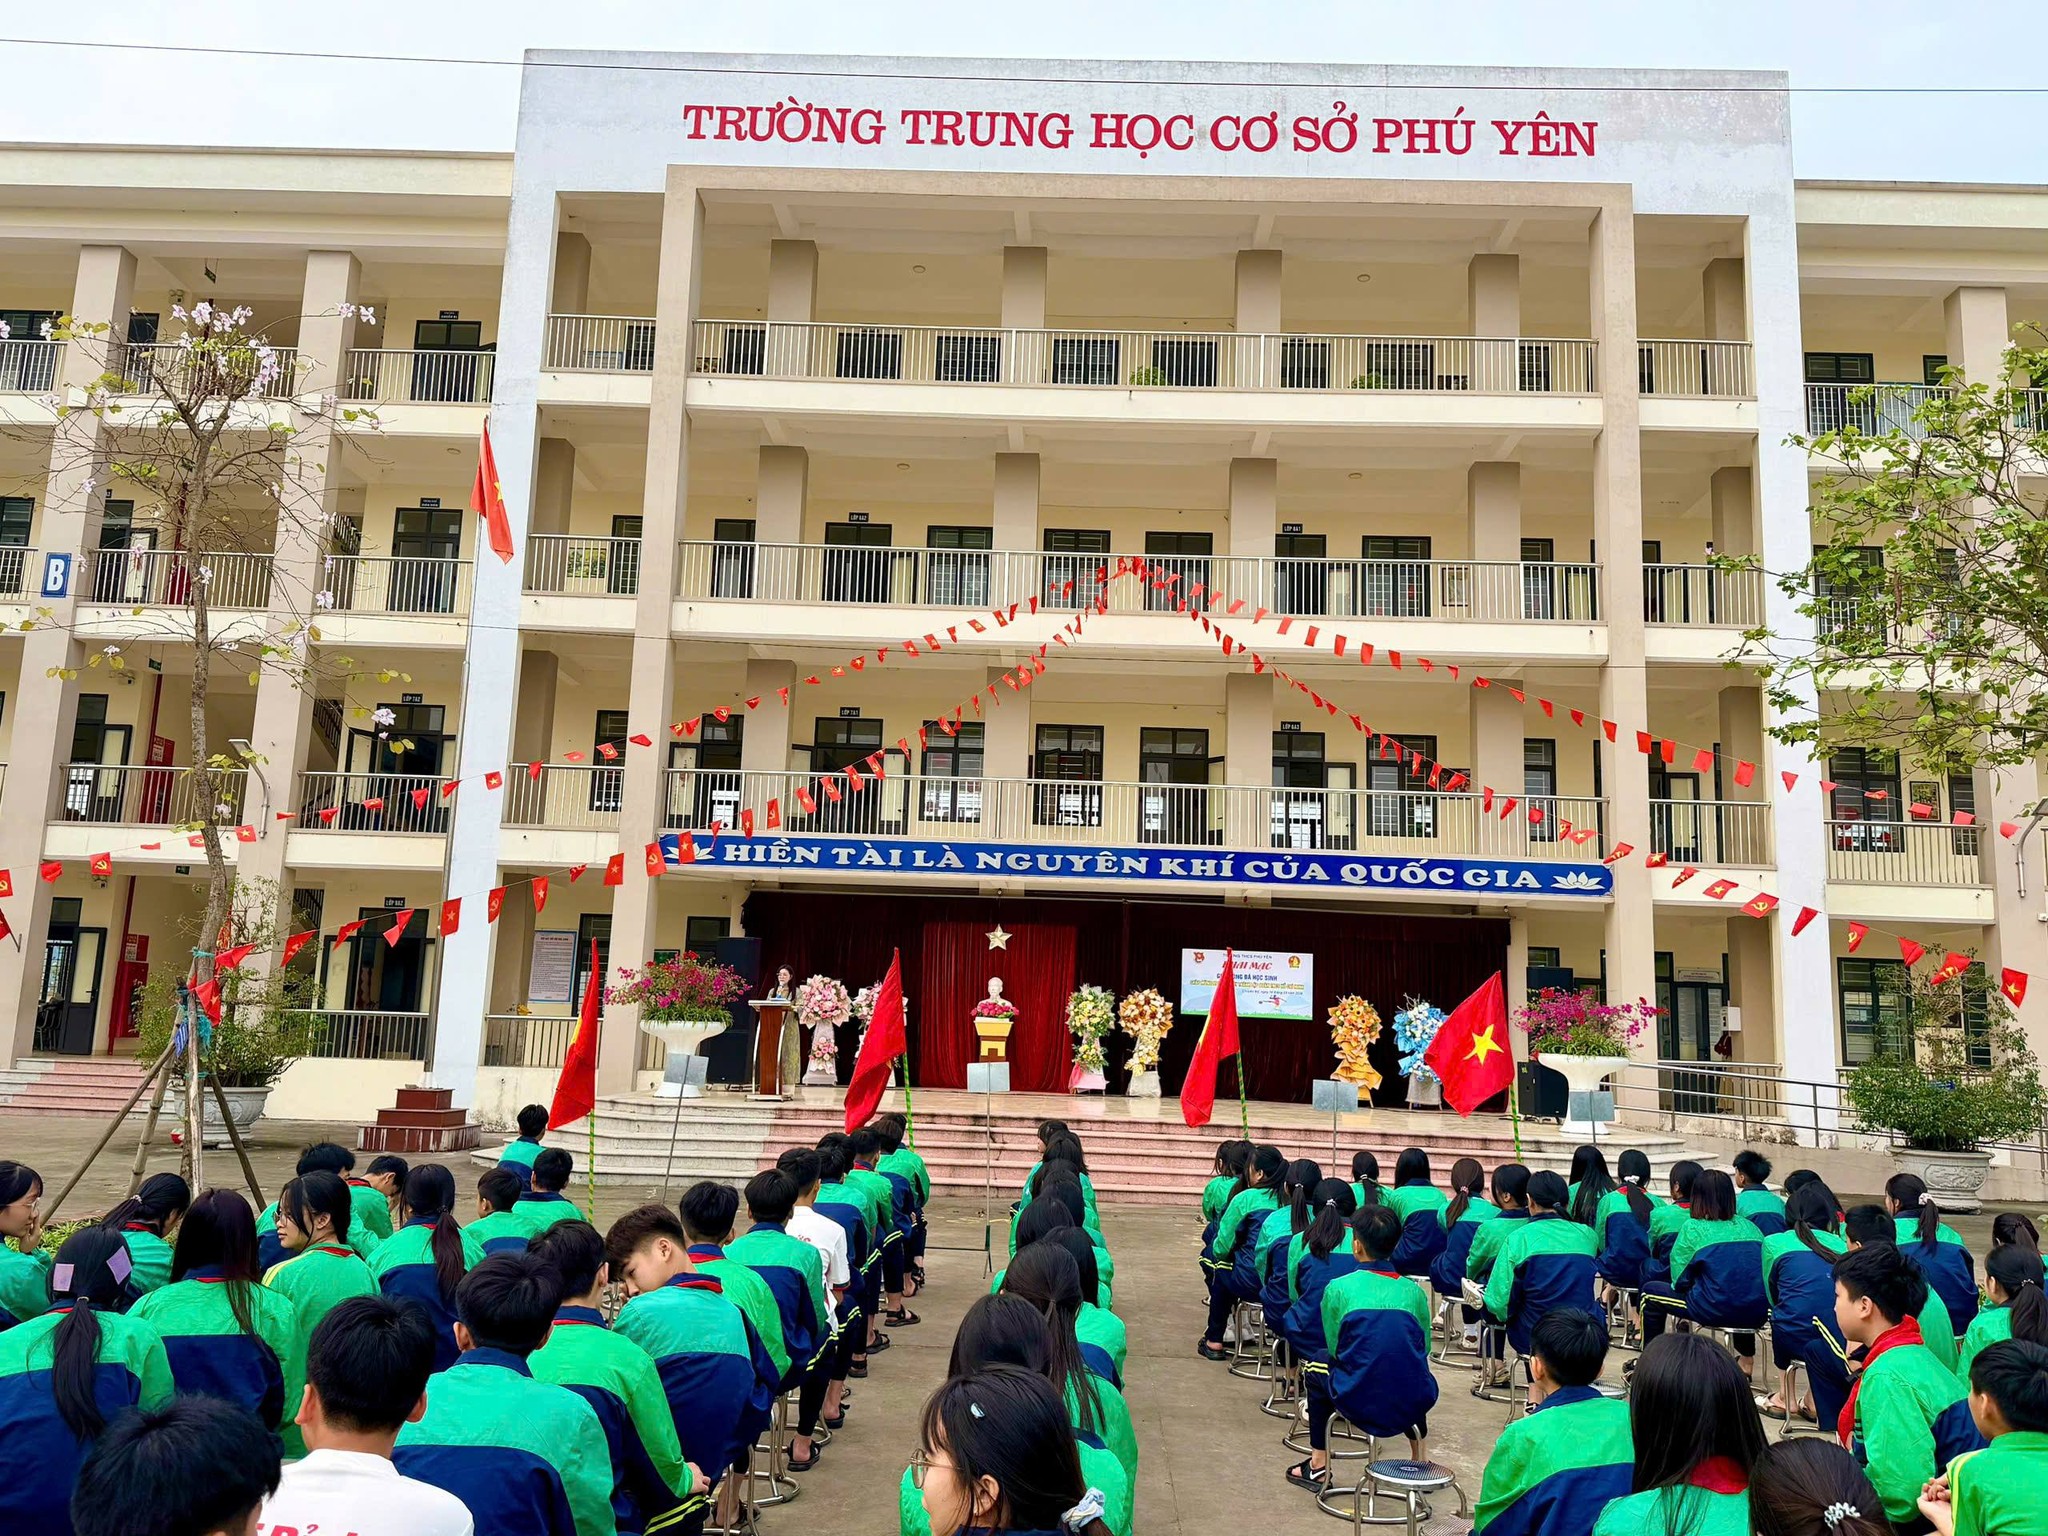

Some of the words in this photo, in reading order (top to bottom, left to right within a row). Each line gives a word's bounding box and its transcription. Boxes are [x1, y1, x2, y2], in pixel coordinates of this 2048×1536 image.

[684, 97, 886, 144] TRƯỜNG
[902, 111, 1074, 149] TRUNG
[1090, 113, 1193, 159] HỌC
[1210, 112, 1278, 152] CƠ
[1293, 102, 1358, 152] SỞ
[1373, 107, 1475, 155] PHÚ
[1492, 111, 1596, 156] YÊN
[46, 559, 65, 590] B
[723, 837, 821, 864] HIỀN
[831, 842, 902, 867] TÀI
[912, 845, 965, 868] LÀ
[975, 850, 1149, 874] NGUYÊN
[1159, 853, 1235, 877] KHÍ
[1243, 855, 1330, 881] CỦA
[1340, 859, 1454, 884] QUỐC
[1462, 869, 1542, 888] GIA
